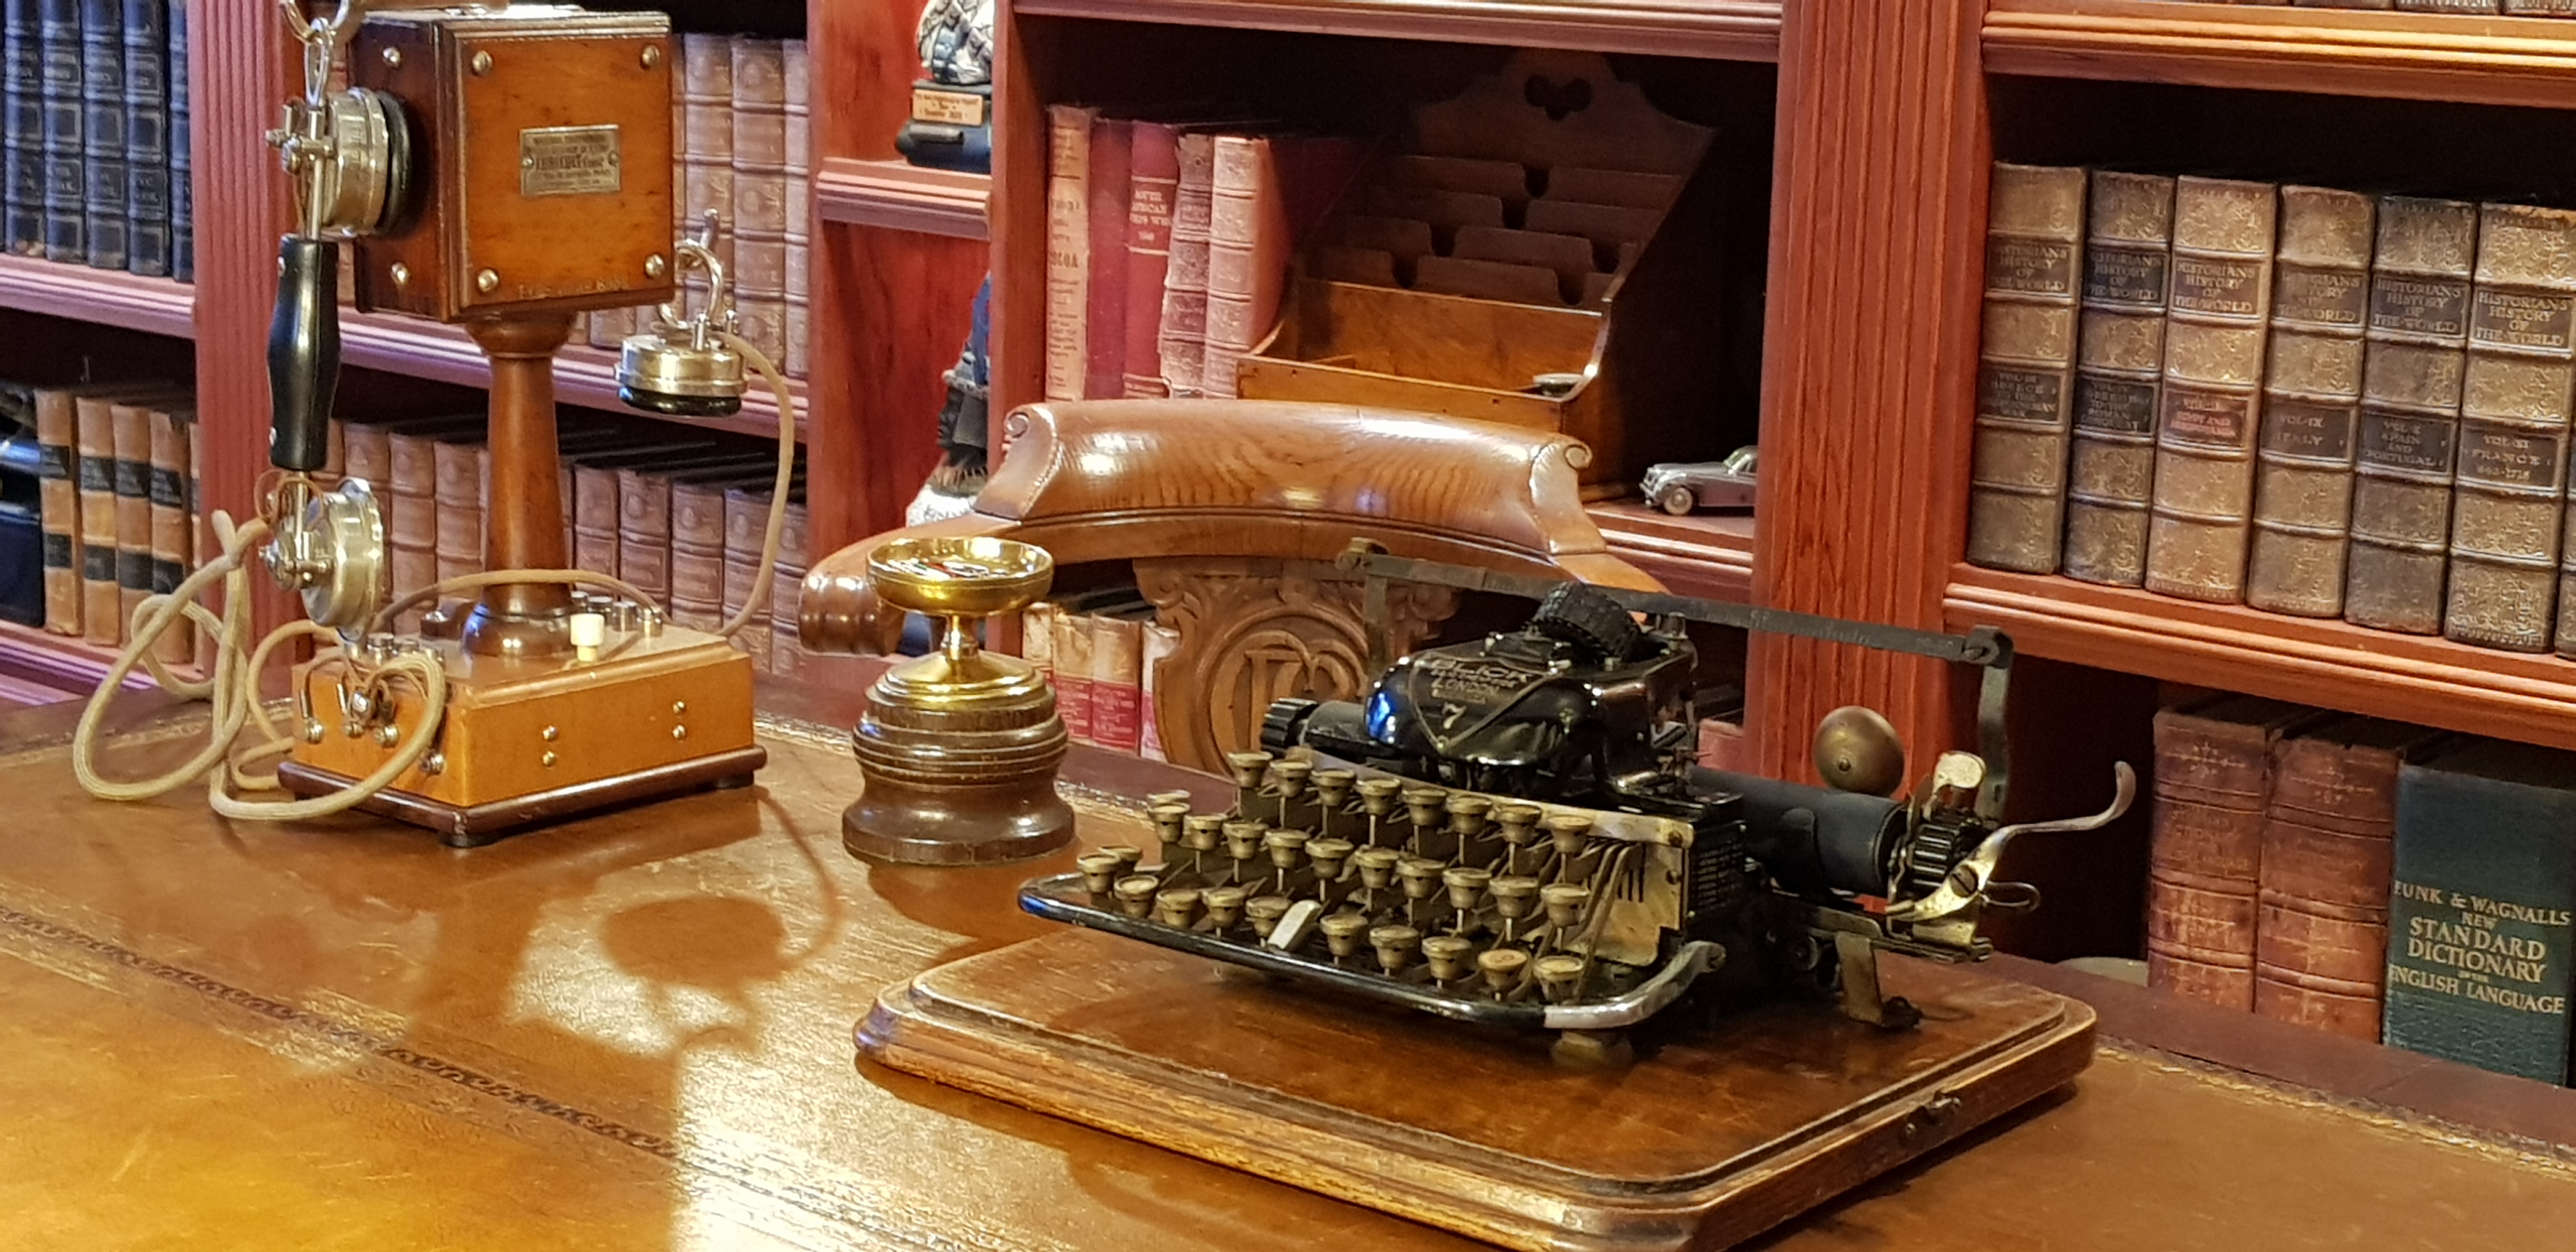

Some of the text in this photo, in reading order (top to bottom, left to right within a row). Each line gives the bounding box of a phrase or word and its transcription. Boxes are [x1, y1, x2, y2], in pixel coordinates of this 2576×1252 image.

[2185, 274, 2244, 290] HISTORY
[2202, 287, 2222, 298] OF
[2386, 292, 2450, 309] HISTORY
[2404, 306, 2425, 317] OF
[2488, 305, 2556, 322] HISTORY
[2508, 319, 2530, 332] OF
[1430, 677, 1500, 696] LONDON
[1441, 701, 1468, 730] 7
[2450, 892, 2467, 909] &
[2470, 896, 2572, 926] WAGNALLS
[2462, 912, 2498, 929] NEW
[2409, 915, 2547, 961] STANDARD
[2407, 936, 2547, 984] DICTIONARY
[2388, 963, 2566, 1014] ENGLISH LANGUAGE
